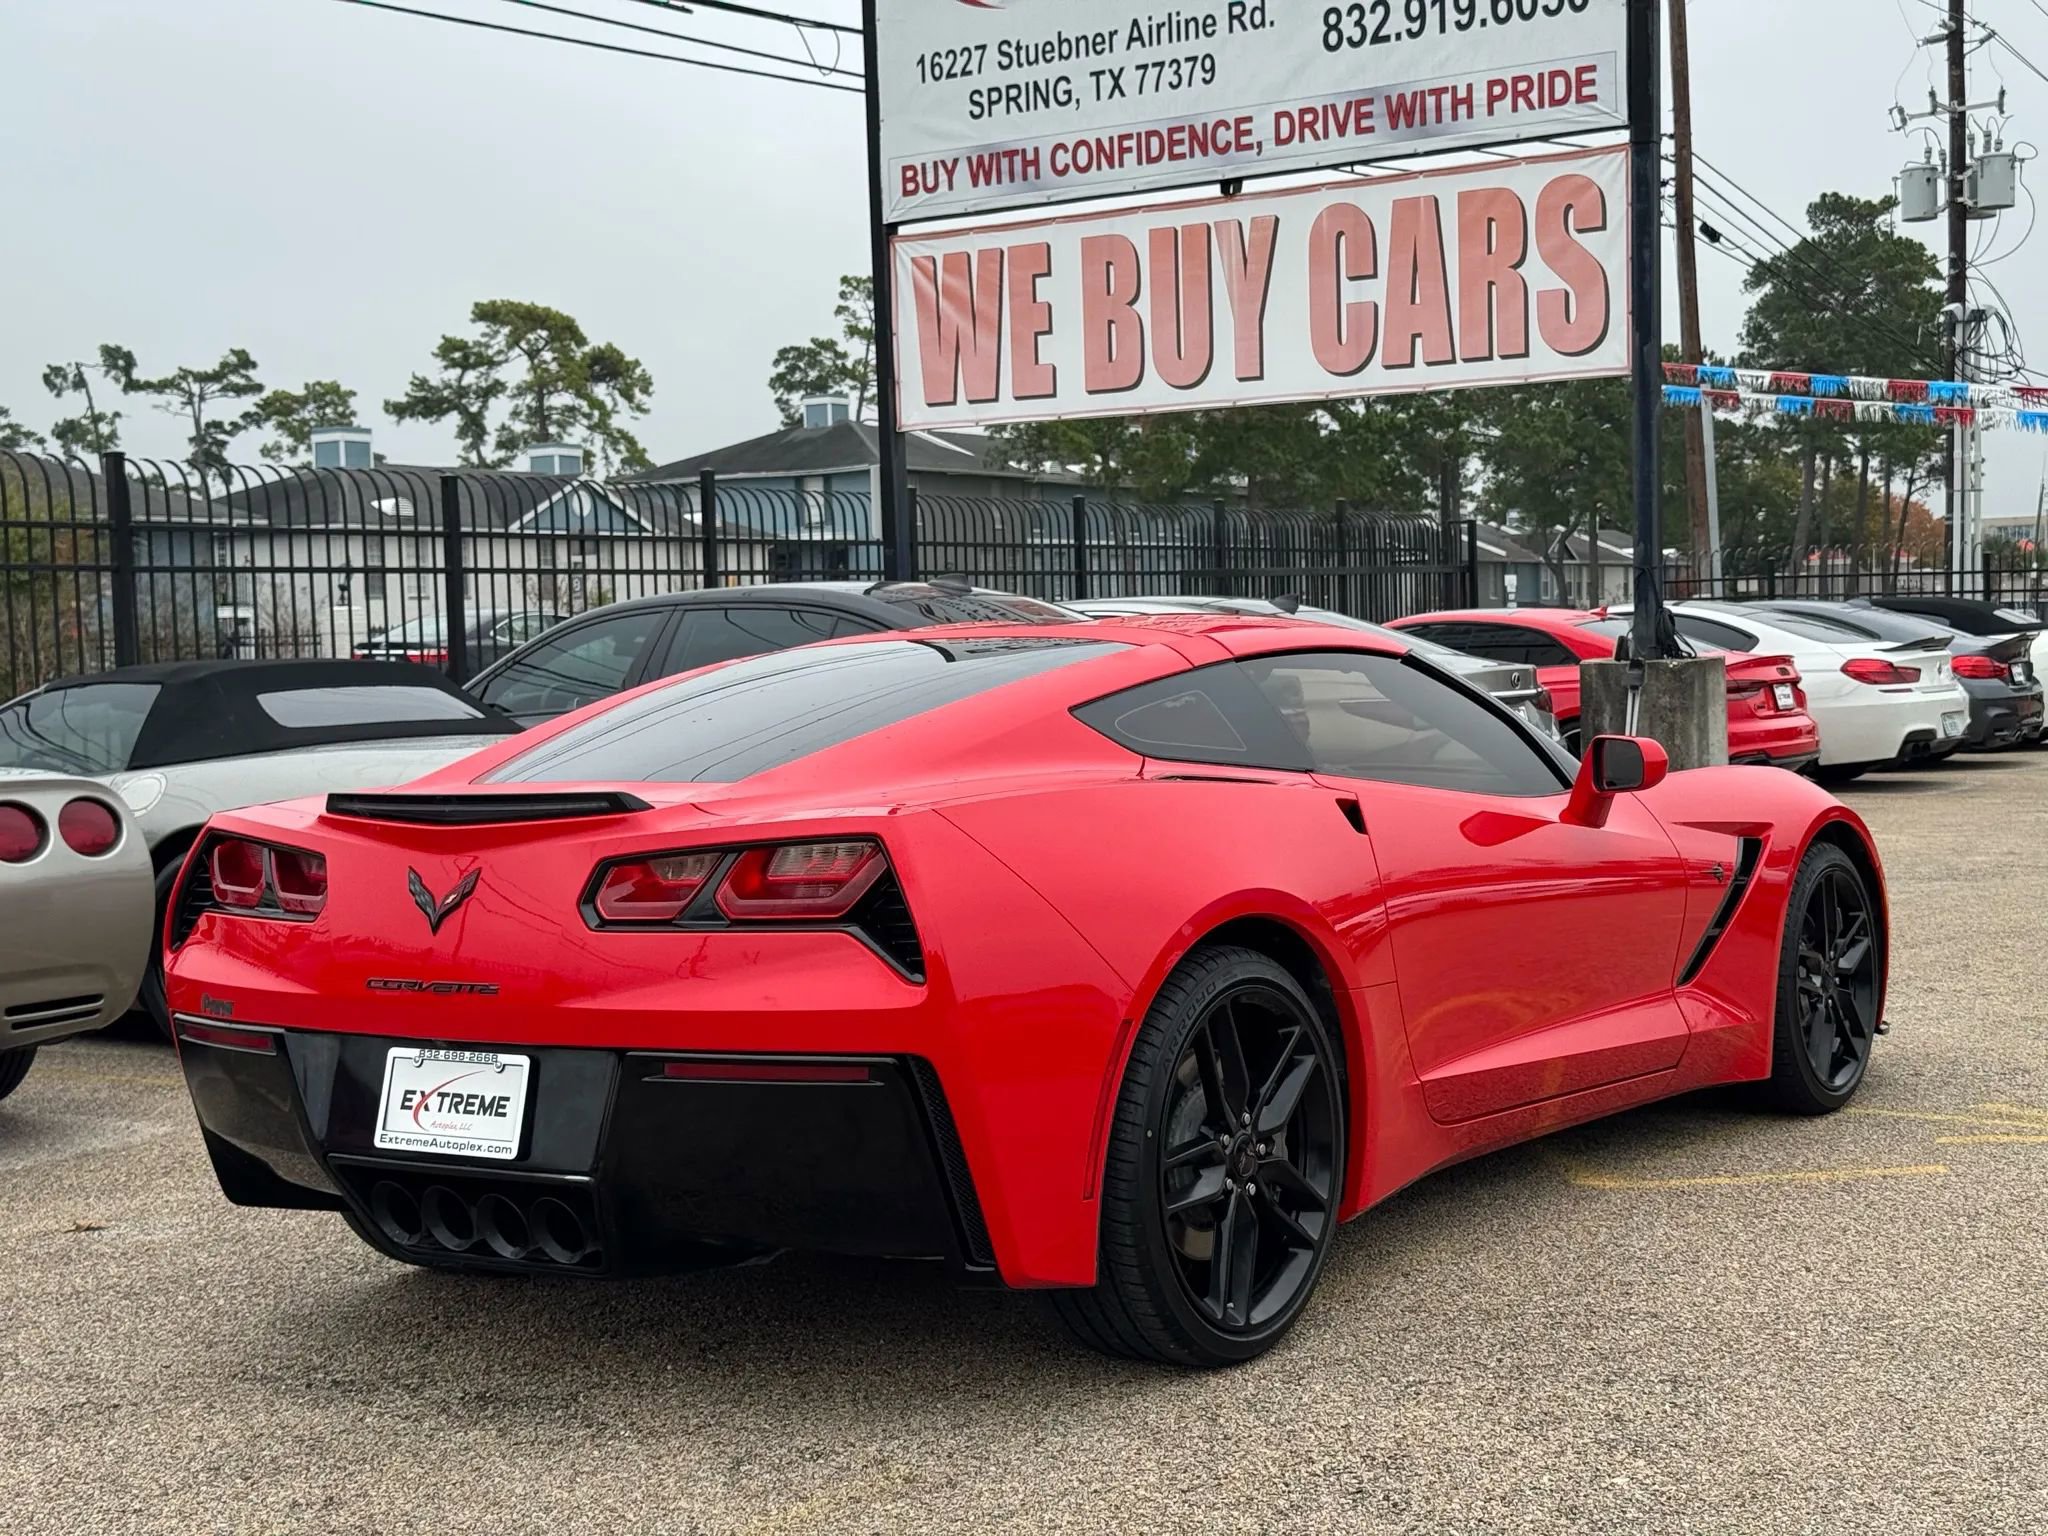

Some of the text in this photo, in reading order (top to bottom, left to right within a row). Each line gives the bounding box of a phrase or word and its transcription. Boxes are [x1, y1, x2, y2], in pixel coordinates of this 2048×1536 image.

[915, 0, 1275, 84] 16227 Stuebner Airline Rd.
[968, 53, 1216, 120] SPRING, TX 77379
[901, 64, 1598, 197] BUY WITH CONFIDENCE, DRIVE WITH PRIDE
[911, 173, 1608, 406] WE BUY CARS
[400, 1089, 511, 1118] EXTREME
[379, 1133, 513, 1155] ExtremeAutoplex.com
